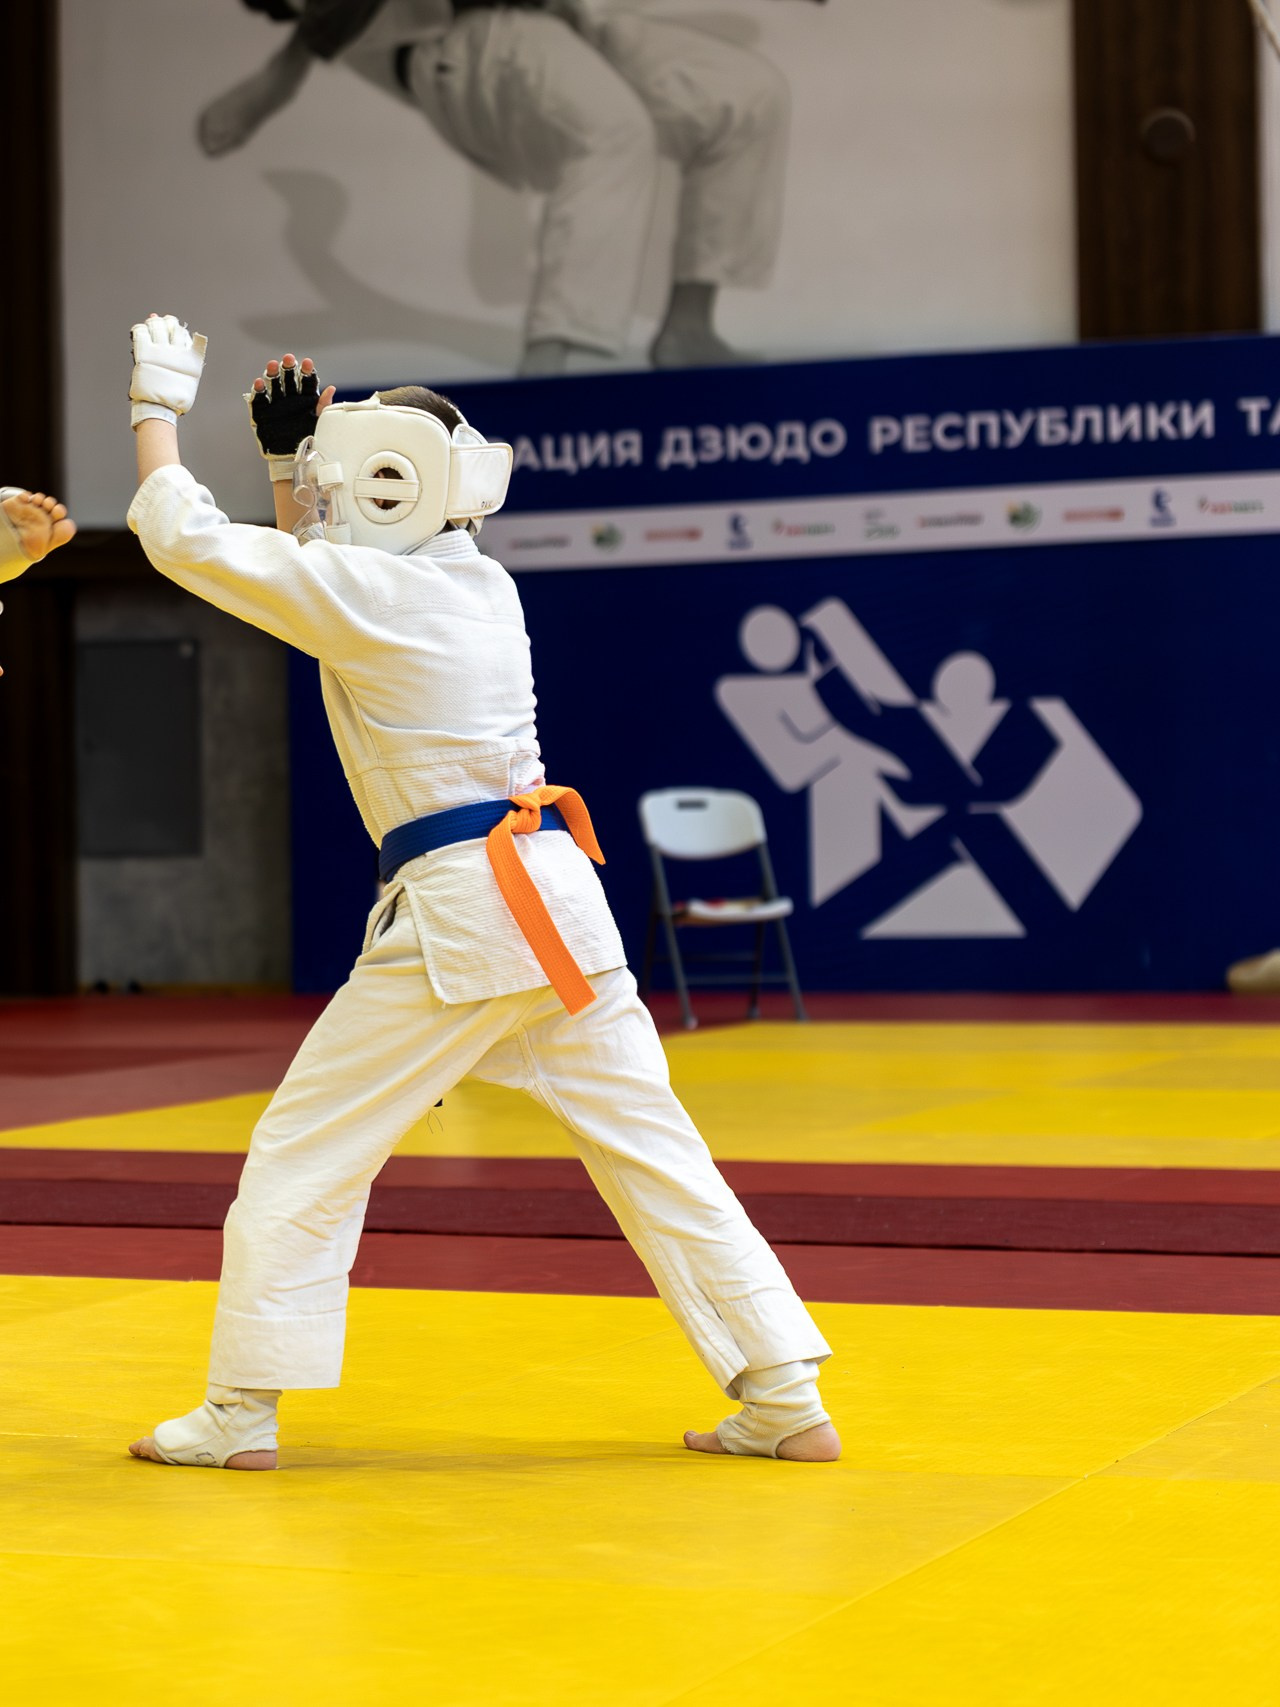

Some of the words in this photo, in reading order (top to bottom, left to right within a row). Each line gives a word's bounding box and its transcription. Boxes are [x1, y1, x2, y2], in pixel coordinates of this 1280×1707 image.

[510, 432, 642, 474] АЦИЯ
[658, 420, 847, 470] ДЗЮДО
[869, 401, 1215, 453] РЕСПУБЛИКИ
[1239, 397, 1280, 436] Т
